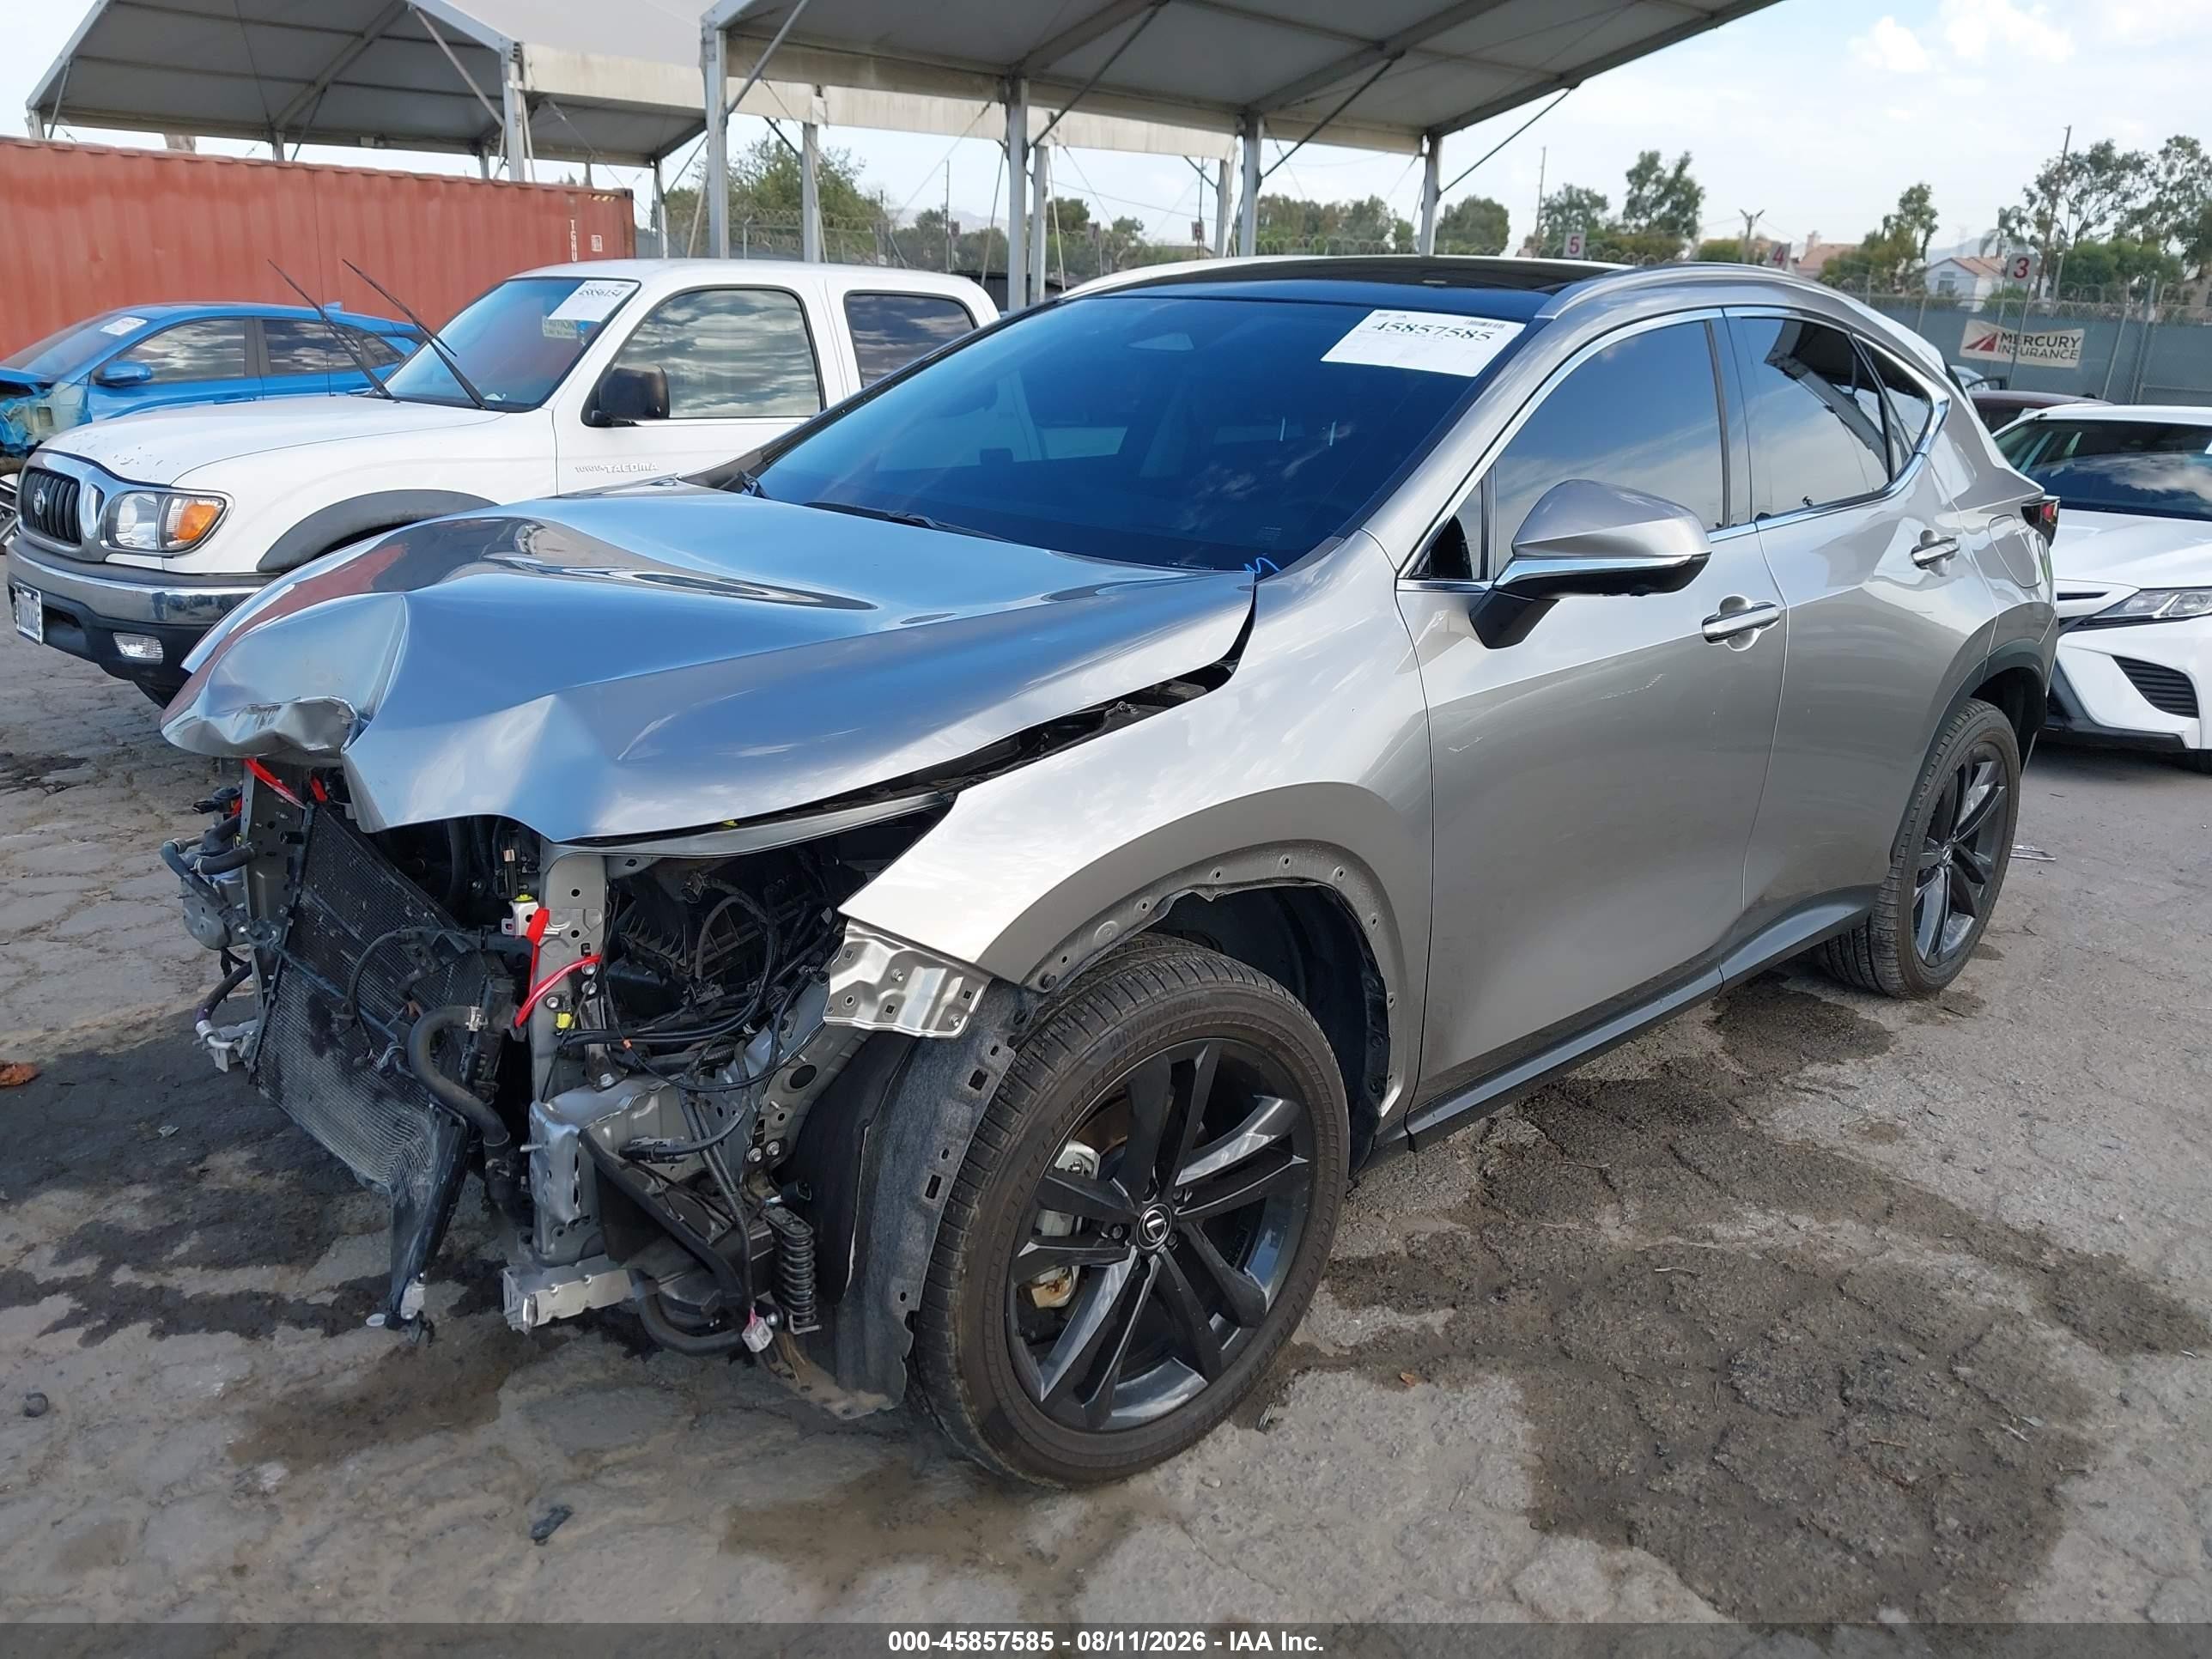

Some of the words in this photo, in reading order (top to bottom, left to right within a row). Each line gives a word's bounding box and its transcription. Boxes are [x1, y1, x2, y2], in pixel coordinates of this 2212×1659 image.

[1569, 236, 1580, 254] 5
[1772, 246, 1785, 265] 4
[2014, 257, 2030, 279] 3
[1372, 321, 1495, 342] 45857585
[2000, 332, 2081, 349] MERCURY
